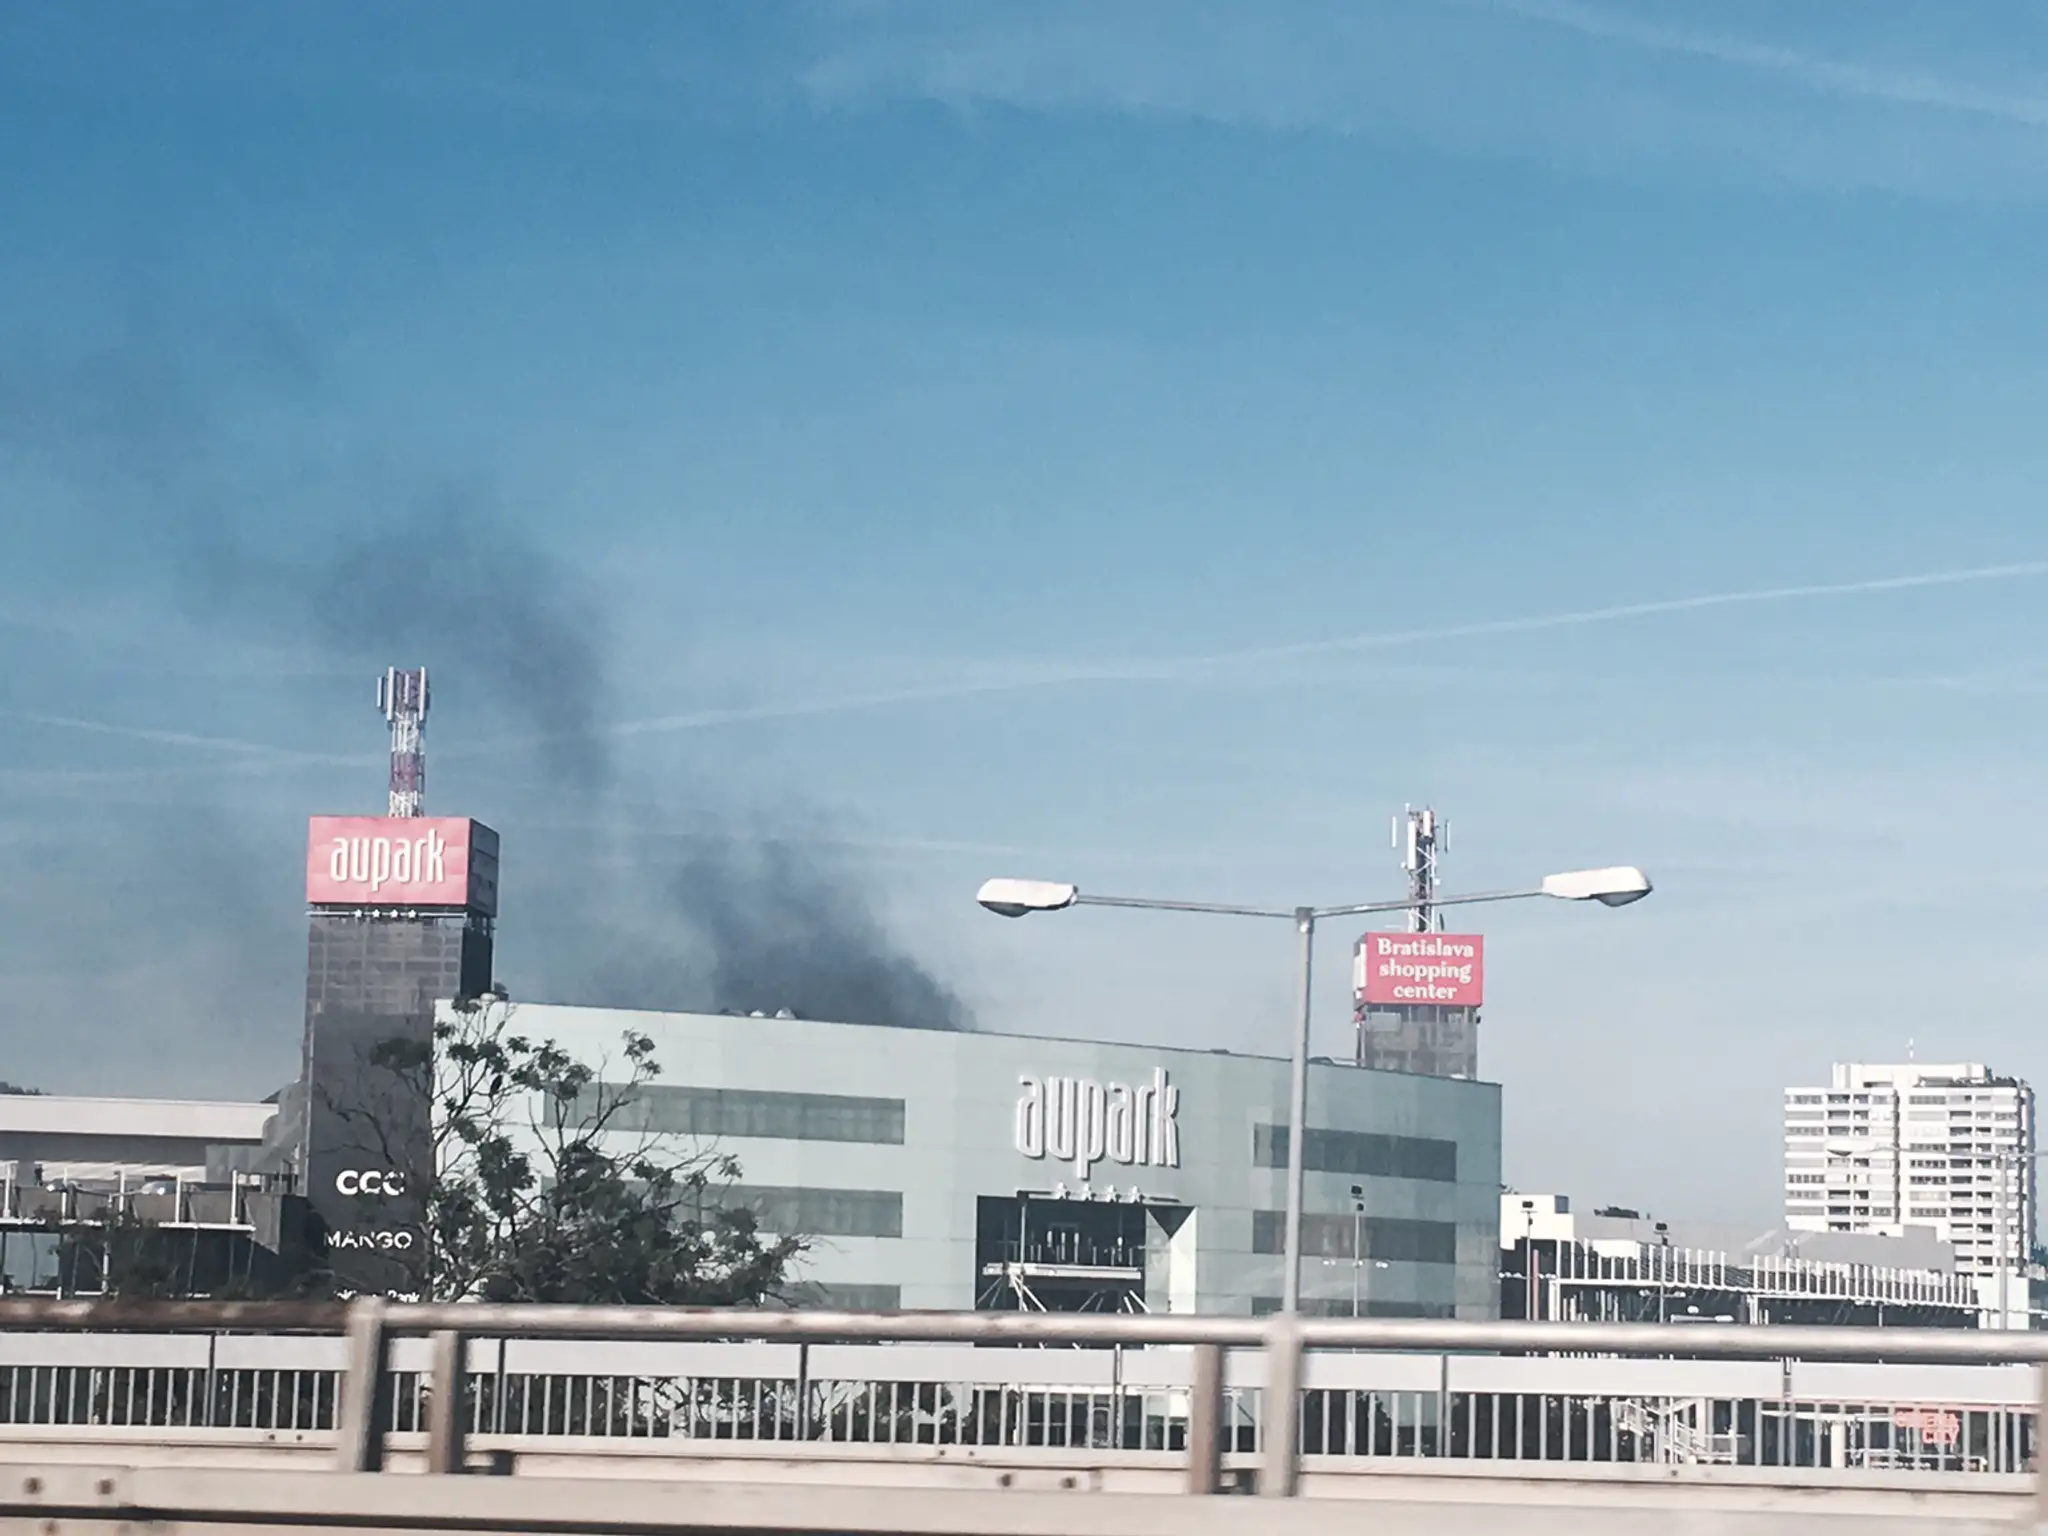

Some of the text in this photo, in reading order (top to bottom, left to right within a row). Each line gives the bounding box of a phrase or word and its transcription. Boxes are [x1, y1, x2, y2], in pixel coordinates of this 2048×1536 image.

[330, 828, 445, 892] aupark
[1377, 937, 1474, 957] Bratislava
[1379, 957, 1472, 984] shopping
[1392, 983, 1457, 999] center
[1016, 1066, 1180, 1180] aupark
[335, 1169, 405, 1196] CCC
[323, 1230, 412, 1249] MANGO
